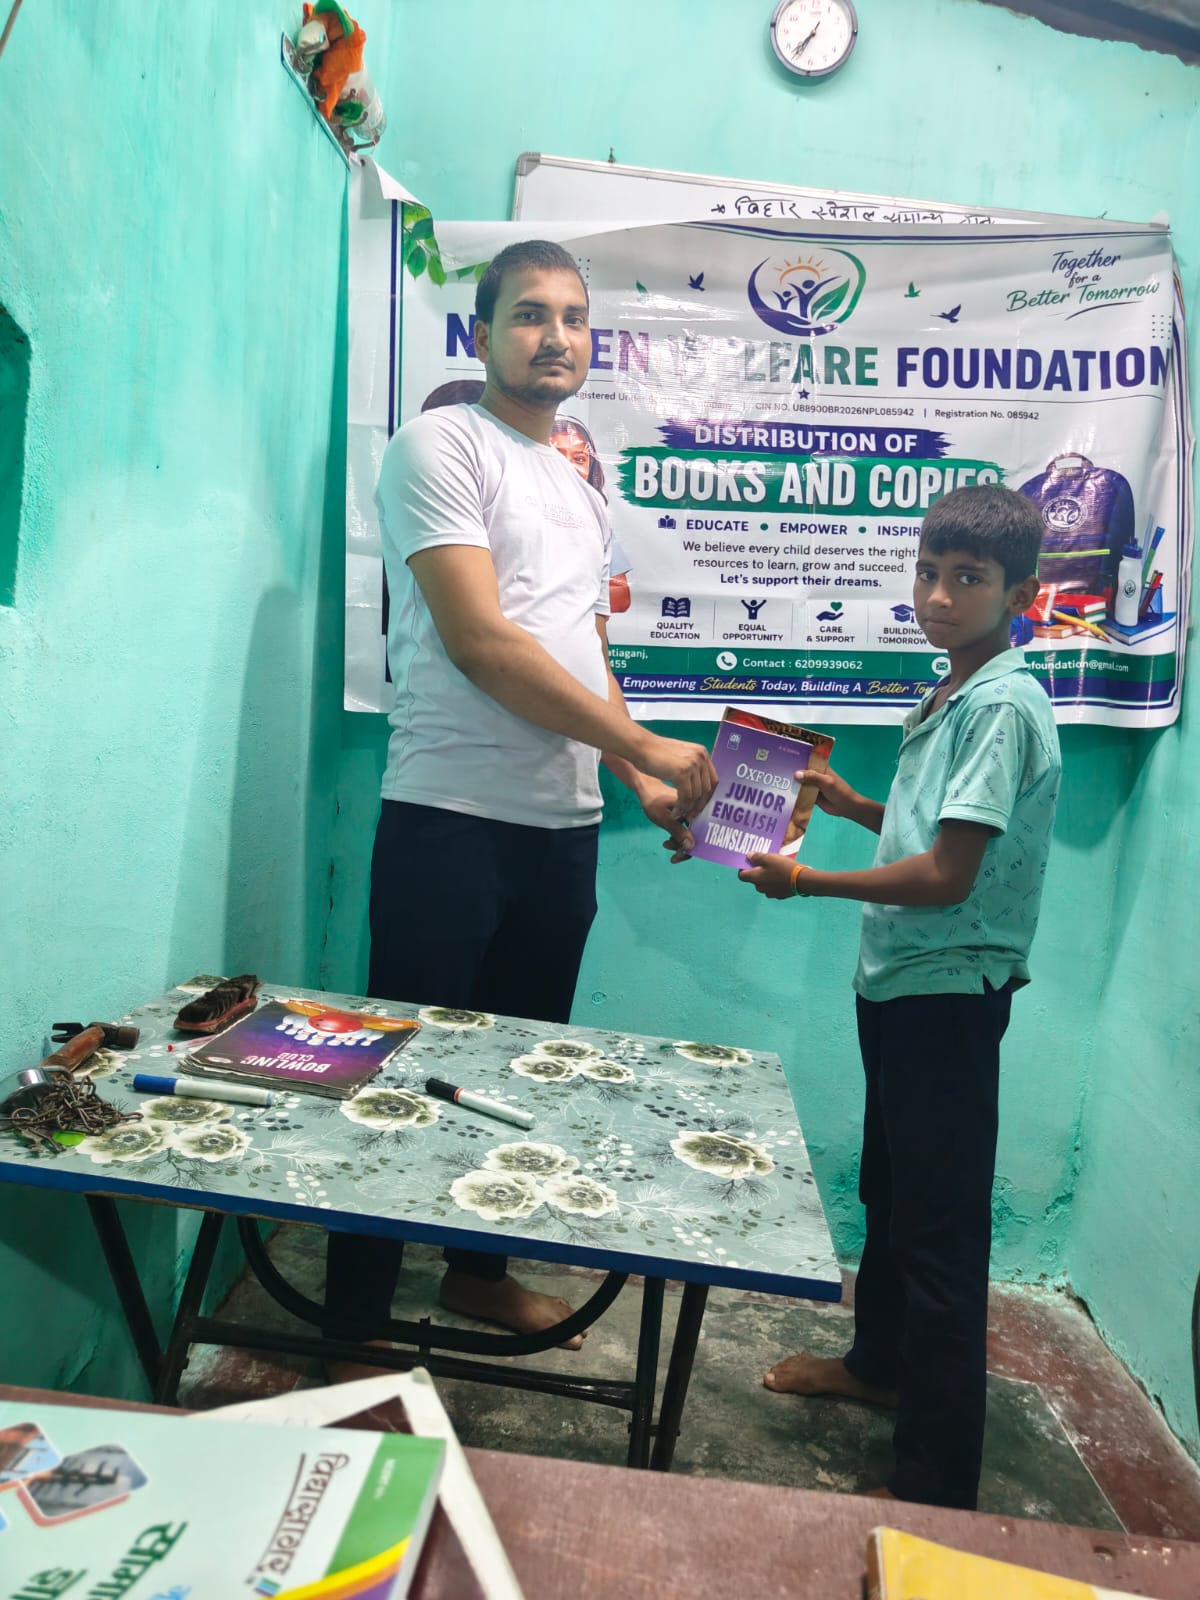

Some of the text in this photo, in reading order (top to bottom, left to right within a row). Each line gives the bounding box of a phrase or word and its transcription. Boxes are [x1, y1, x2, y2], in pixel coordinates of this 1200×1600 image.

[1052, 248, 1121, 278] Together
[1068, 272, 1101, 288] for a
[1006, 282, 1160, 312] Better Tomorrow
[897, 346, 1170, 391] FOUNDATION
[574, 391, 616, 401] egistered
[755, 402, 771, 410] CIN
[935, 409, 1040, 421] Registration No. 085942
[695, 425, 918, 453] DISTRIBUTION OF
[635, 456, 766, 503] BOOKS
[779, 462, 856, 507] AND
[686, 519, 749, 532] EDUCATE
[780, 523, 848, 535] EMPOWER
[683, 541, 917, 560] We believe every child deserves the right
[693, 557, 908, 573] resources to learn, grow and succeed.
[720, 573, 882, 588] Let's support their dreams.
[656, 622, 694, 630] QUALITY
[738, 624, 767, 632] EQUAL
[820, 626, 843, 634] CARE
[883, 627, 924, 636] BUILDING
[650, 632, 700, 640] EDUCATION
[722, 633, 784, 641] OPPORTUNITY
[806, 635, 855, 643] & SUPPORT
[878, 637, 928, 645] TOMORROW
[743, 658, 863, 670] Contact 6209939062
[623, 677, 696, 691] Empowering
[700, 676, 757, 691] Students
[761, 680, 797, 693] Today,
[801, 680, 850, 694] Building
[853, 683, 862, 692] A
[866, 681, 909, 695] Better
[736, 763, 791, 791] OXFORD
[725, 782, 786, 813] JUNIOR
[711, 801, 778, 834] ENGLISH
[704, 822, 772, 855] TRANSLATION
[240, 1056, 331, 1073] BOWLING
[277, 1052, 314, 1062] CLUB
